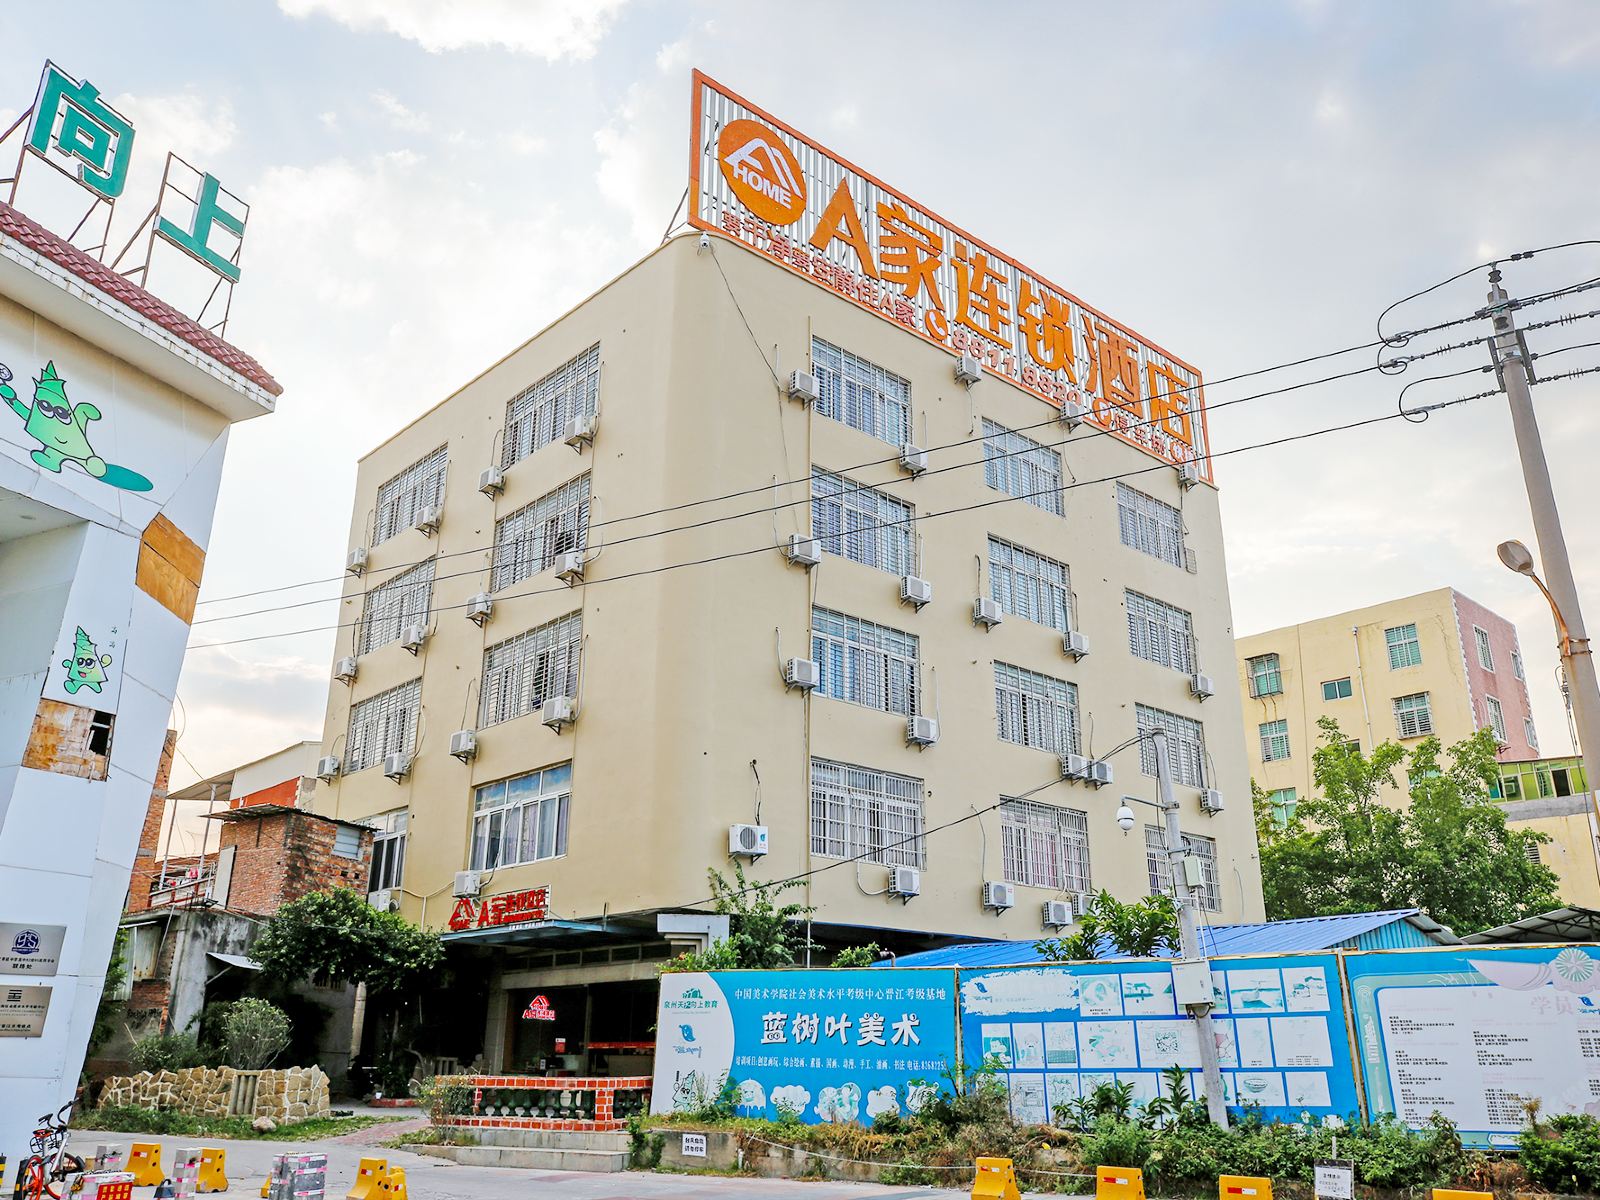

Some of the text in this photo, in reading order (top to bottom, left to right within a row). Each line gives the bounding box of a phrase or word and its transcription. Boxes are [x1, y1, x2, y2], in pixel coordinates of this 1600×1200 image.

[25, 65, 245, 283] 向上
[731, 162, 792, 209] HOME
[722, 211, 916, 327] 要干净要安静住A家
[809, 177, 1193, 447] A家连锁酒店
[952, 329, 1082, 406] 8811 8820
[734, 987, 946, 1000] 中国美术学院社会美术水平考级中心晋江考级基地
[760, 1011, 922, 1047] 蓝树叶美术
